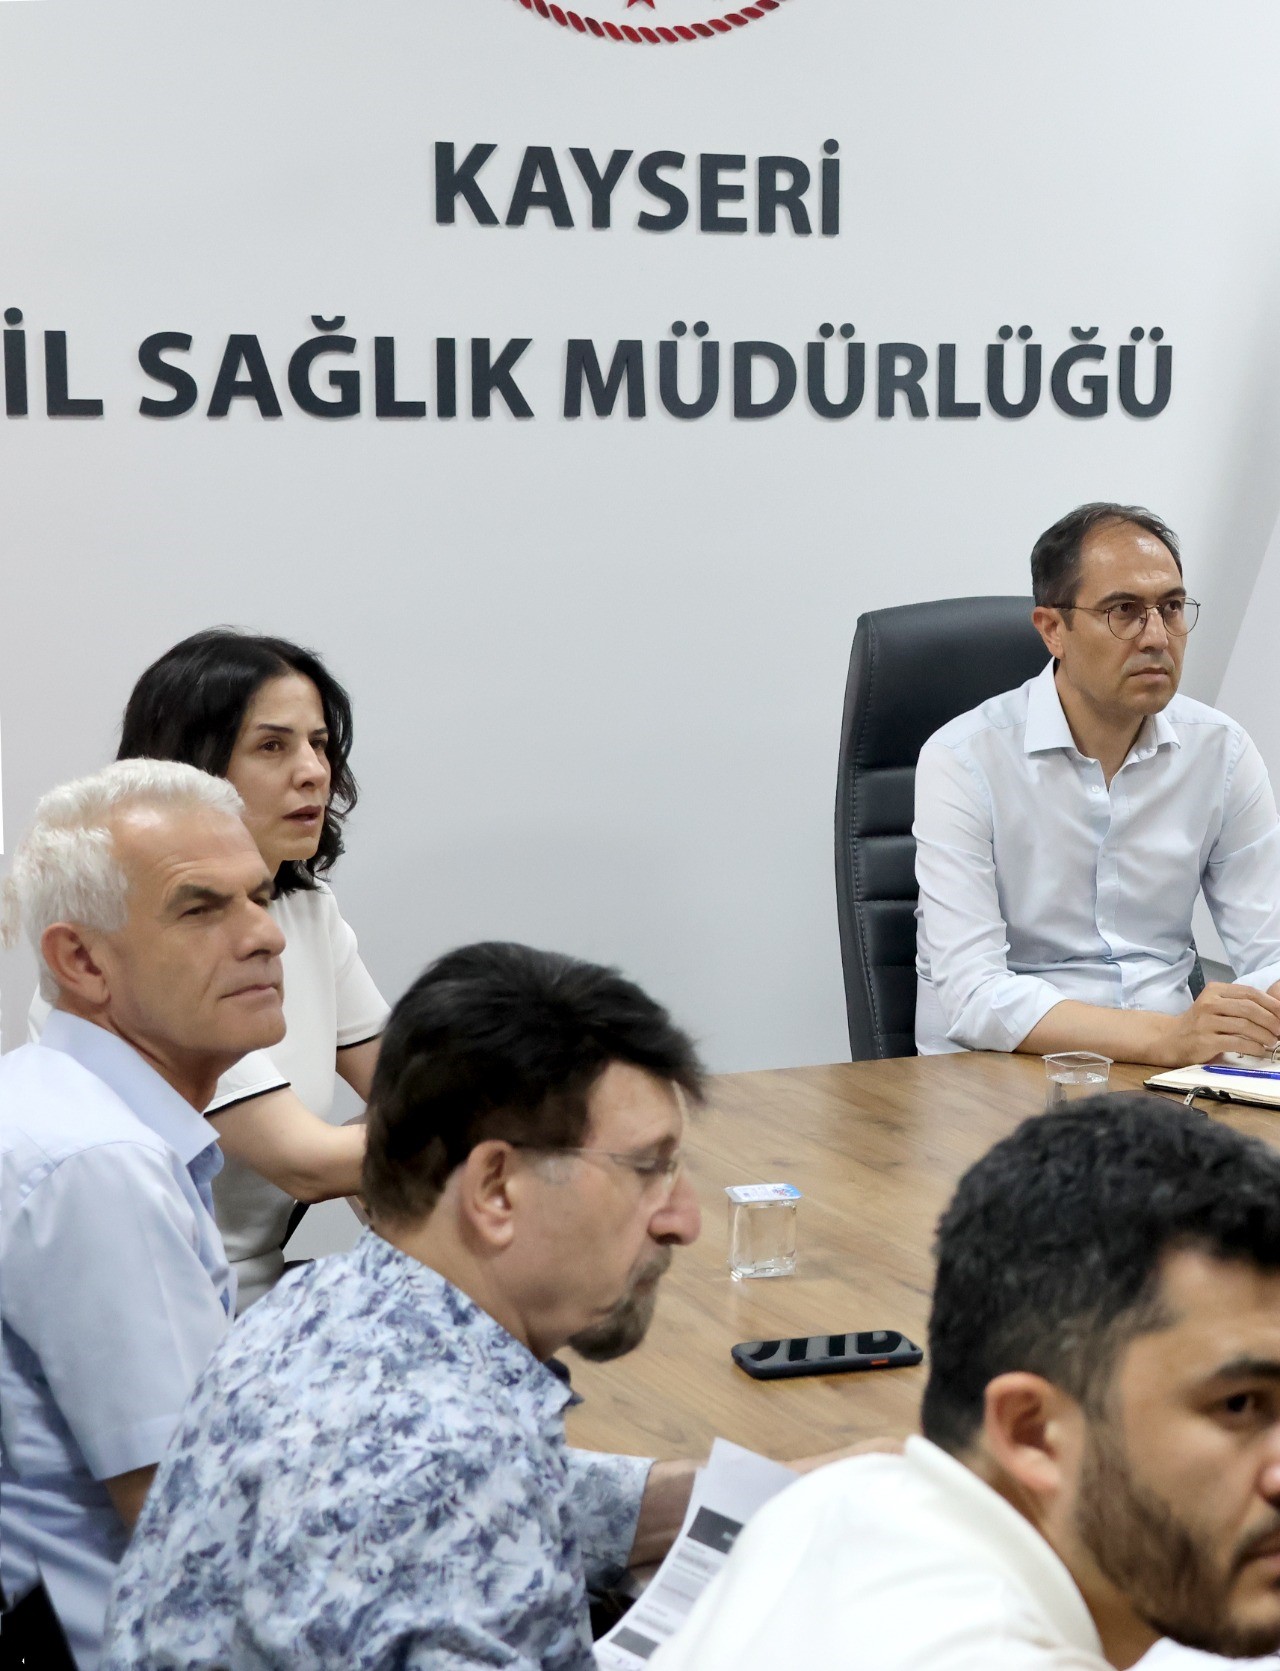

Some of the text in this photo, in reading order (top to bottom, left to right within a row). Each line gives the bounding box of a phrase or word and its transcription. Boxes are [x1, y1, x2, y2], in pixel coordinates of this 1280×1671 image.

[434, 138, 841, 236] KAYSERİ
[3, 307, 1173, 421] İL SAĞLIK MÜDÜRLÜĞÜ
